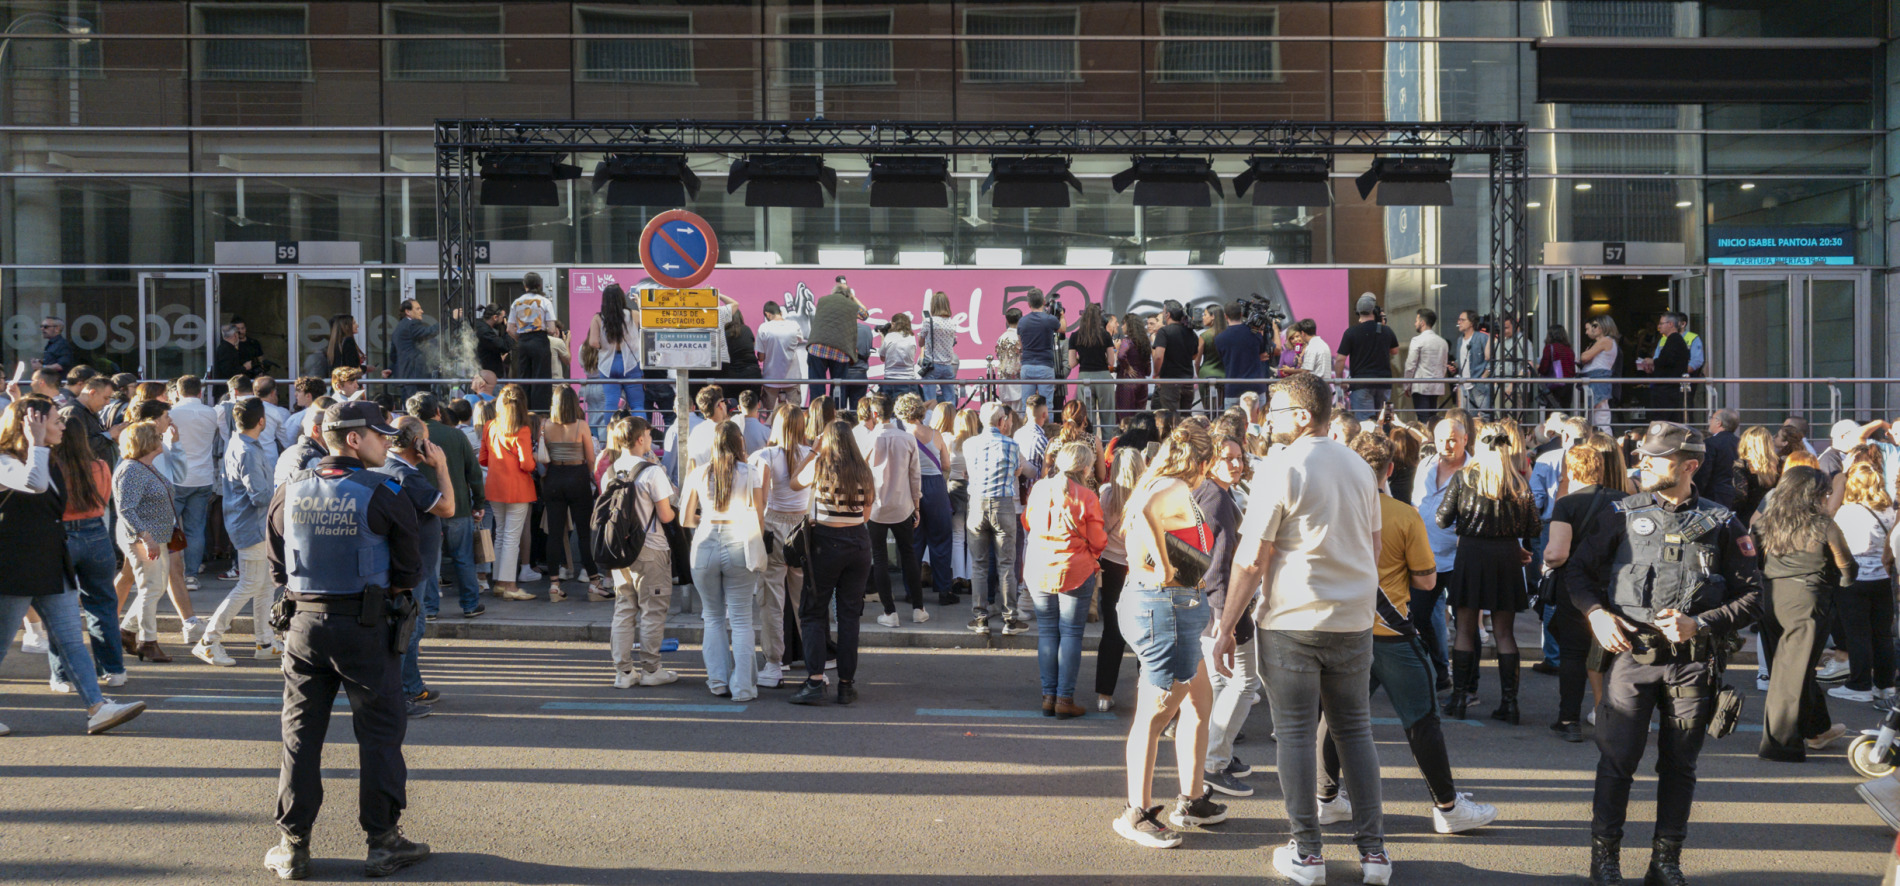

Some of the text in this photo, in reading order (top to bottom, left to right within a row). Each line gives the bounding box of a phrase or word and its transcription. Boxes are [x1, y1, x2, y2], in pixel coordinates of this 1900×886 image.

[1718, 237, 1843, 247] INICIO ISABEL PANTOJA 20:30
[278, 246, 297, 259] 59
[1606, 247, 1623, 260] 57
[1735, 256, 1773, 265] APERTURA
[292, 493, 357, 512] POLICÍA
[291, 511, 357, 525] MUNICIPAL
[314, 525, 358, 536] Madrid
